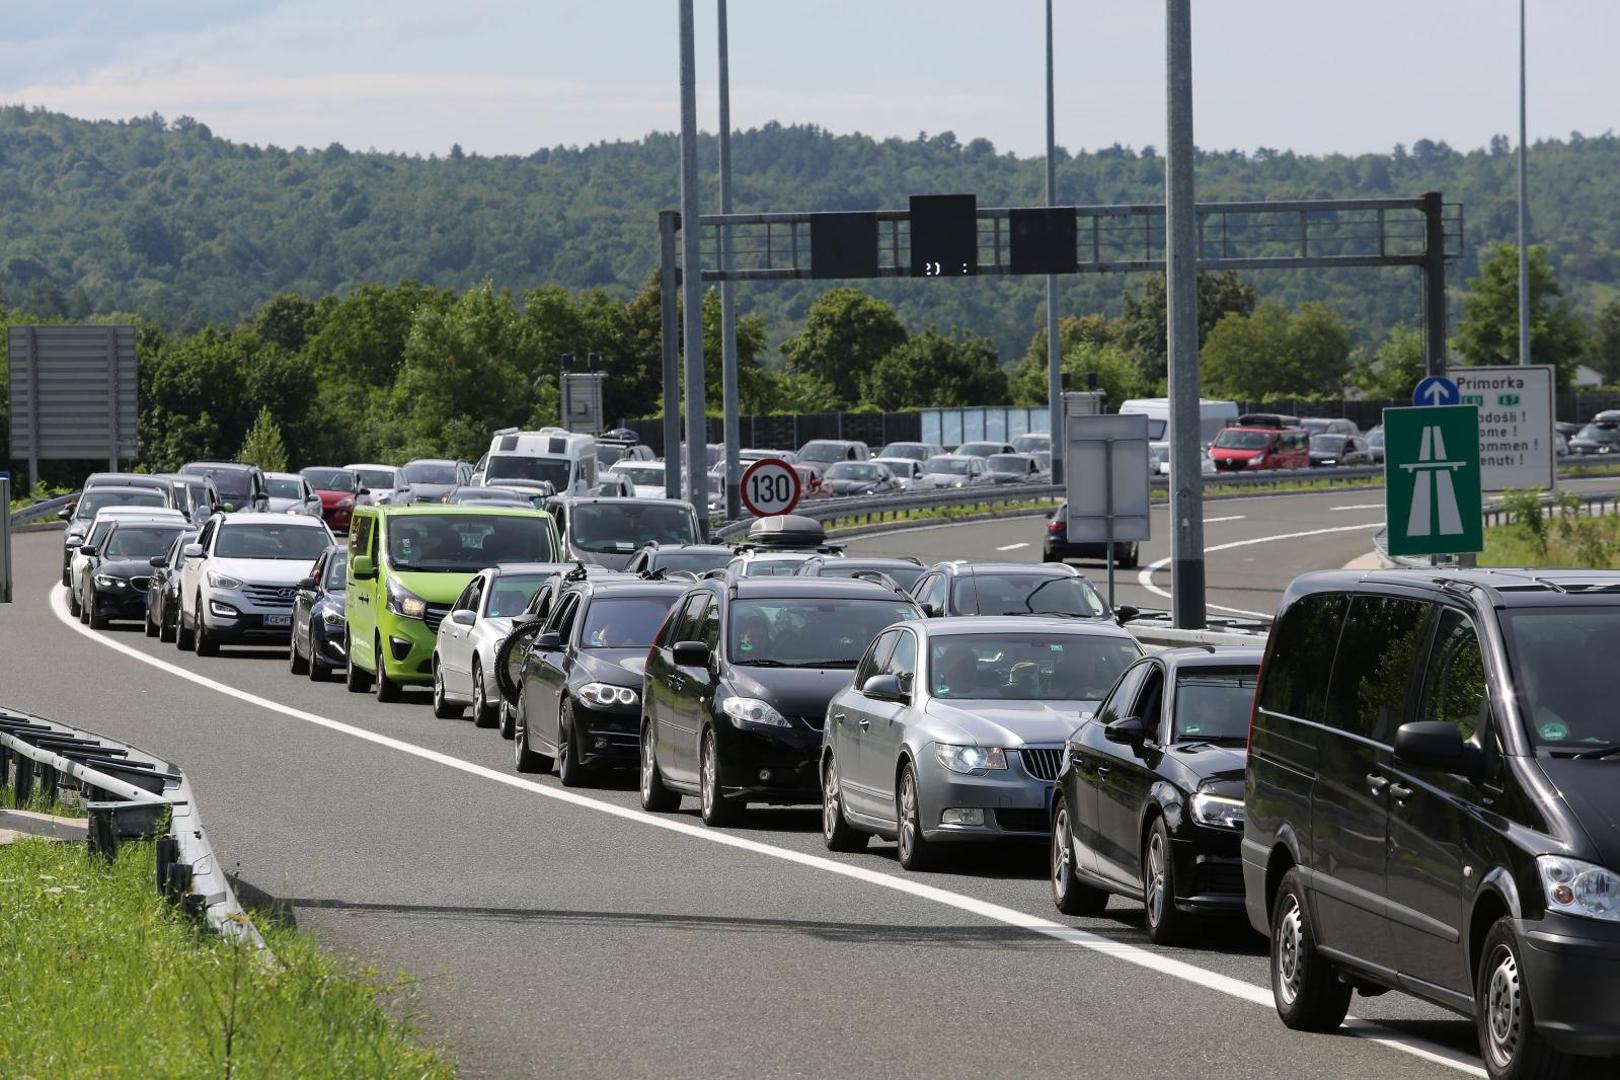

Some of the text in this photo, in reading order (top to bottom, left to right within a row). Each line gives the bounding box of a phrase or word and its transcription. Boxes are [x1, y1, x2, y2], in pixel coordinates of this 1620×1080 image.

[1456, 376, 1524, 389] Primorka
[1521, 410, 1526, 423] !
[1513, 425, 1517, 437] !
[1533, 439, 1538, 451] !
[1519, 453, 1524, 465] !
[752, 474, 790, 503] 130
